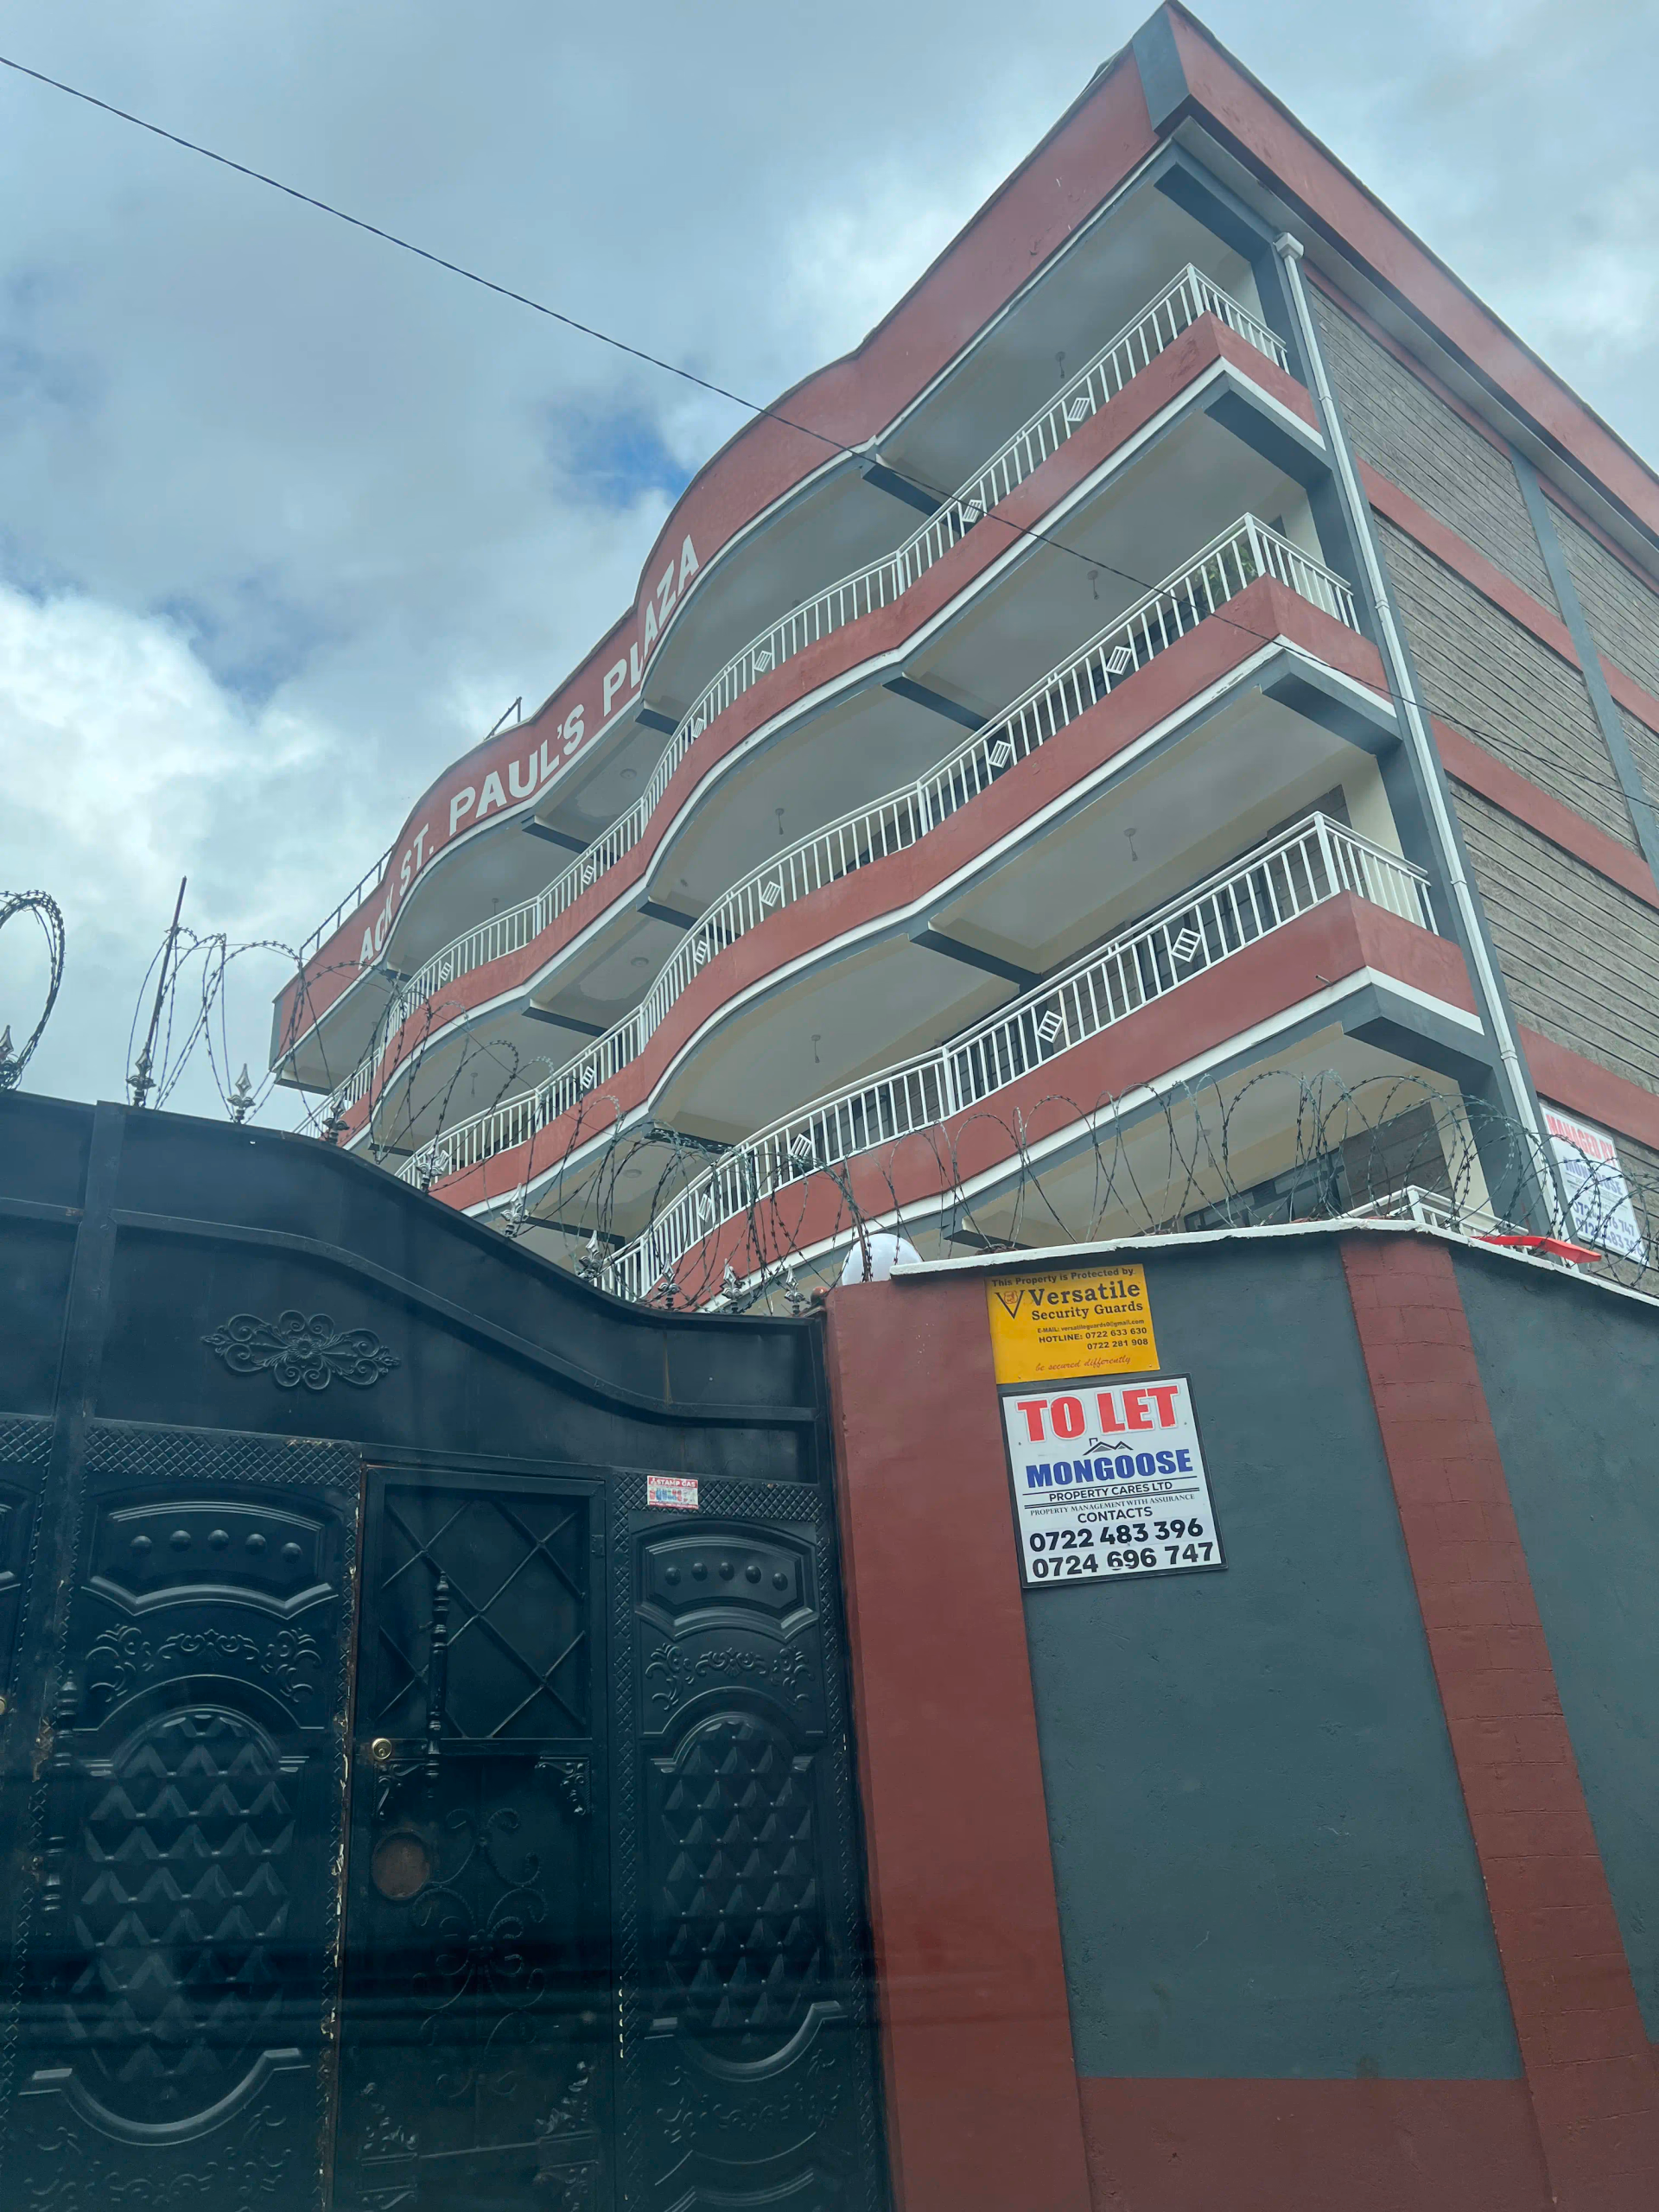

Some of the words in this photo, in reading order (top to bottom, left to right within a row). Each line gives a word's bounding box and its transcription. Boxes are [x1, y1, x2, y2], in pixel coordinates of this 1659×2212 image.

[358, 883, 395, 969] ACK
[398, 823, 434, 897] ST.
[448, 703, 585, 836] PAUL'S
[603, 534, 700, 717] PLAZA
[1546, 1114, 1602, 1160] MANAGED
[992, 1278, 1013, 1287] This
[1015, 1274, 1057, 1286] Property
[1070, 1268, 1119, 1280] Protected
[1029, 1280, 1141, 1306] Versatile
[1032, 1306, 1090, 1321] Security
[1094, 1301, 1143, 1316] Guards
[1039, 1333, 1083, 1344] HOTLINE:
[1085, 1330, 1108, 1339] 0722
[1110, 1328, 1128, 1338] 633
[1130, 1326, 1147, 1335] 630
[1087, 1340, 1109, 1350] 0722
[1112, 1339, 1128, 1348] 281
[1131, 1338, 1148, 1346] 908
[1035, 1362, 1045, 1371] be
[1048, 1358, 1080, 1370] secured
[1084, 1355, 1131, 1370] differently
[1016, 1395, 1085, 1443] TO
[1096, 1384, 1179, 1433] LET
[1026, 1449, 1193, 1488] MONGOOSE
[1049, 1487, 1109, 1502] PROPERTY
[1111, 1484, 1150, 1496] CARES
[1152, 1481, 1173, 1492] LTD
[1030, 1506, 1069, 1516] PROPERTY
[1071, 1500, 1125, 1512] MANAGEMENT
[1126, 1497, 1147, 1507] WITH
[1149, 1493, 1194, 1504] ASSURANCE
[1077, 1506, 1153, 1523] CONTACTS
[1029, 1529, 1094, 1552] 0722
[1100, 1522, 1148, 1545] 483
[1154, 1518, 1204, 1540] 396
[1032, 1554, 1098, 1578] 0724
[1106, 1548, 1157, 1571] 696
[1164, 1541, 1213, 1565] 747
